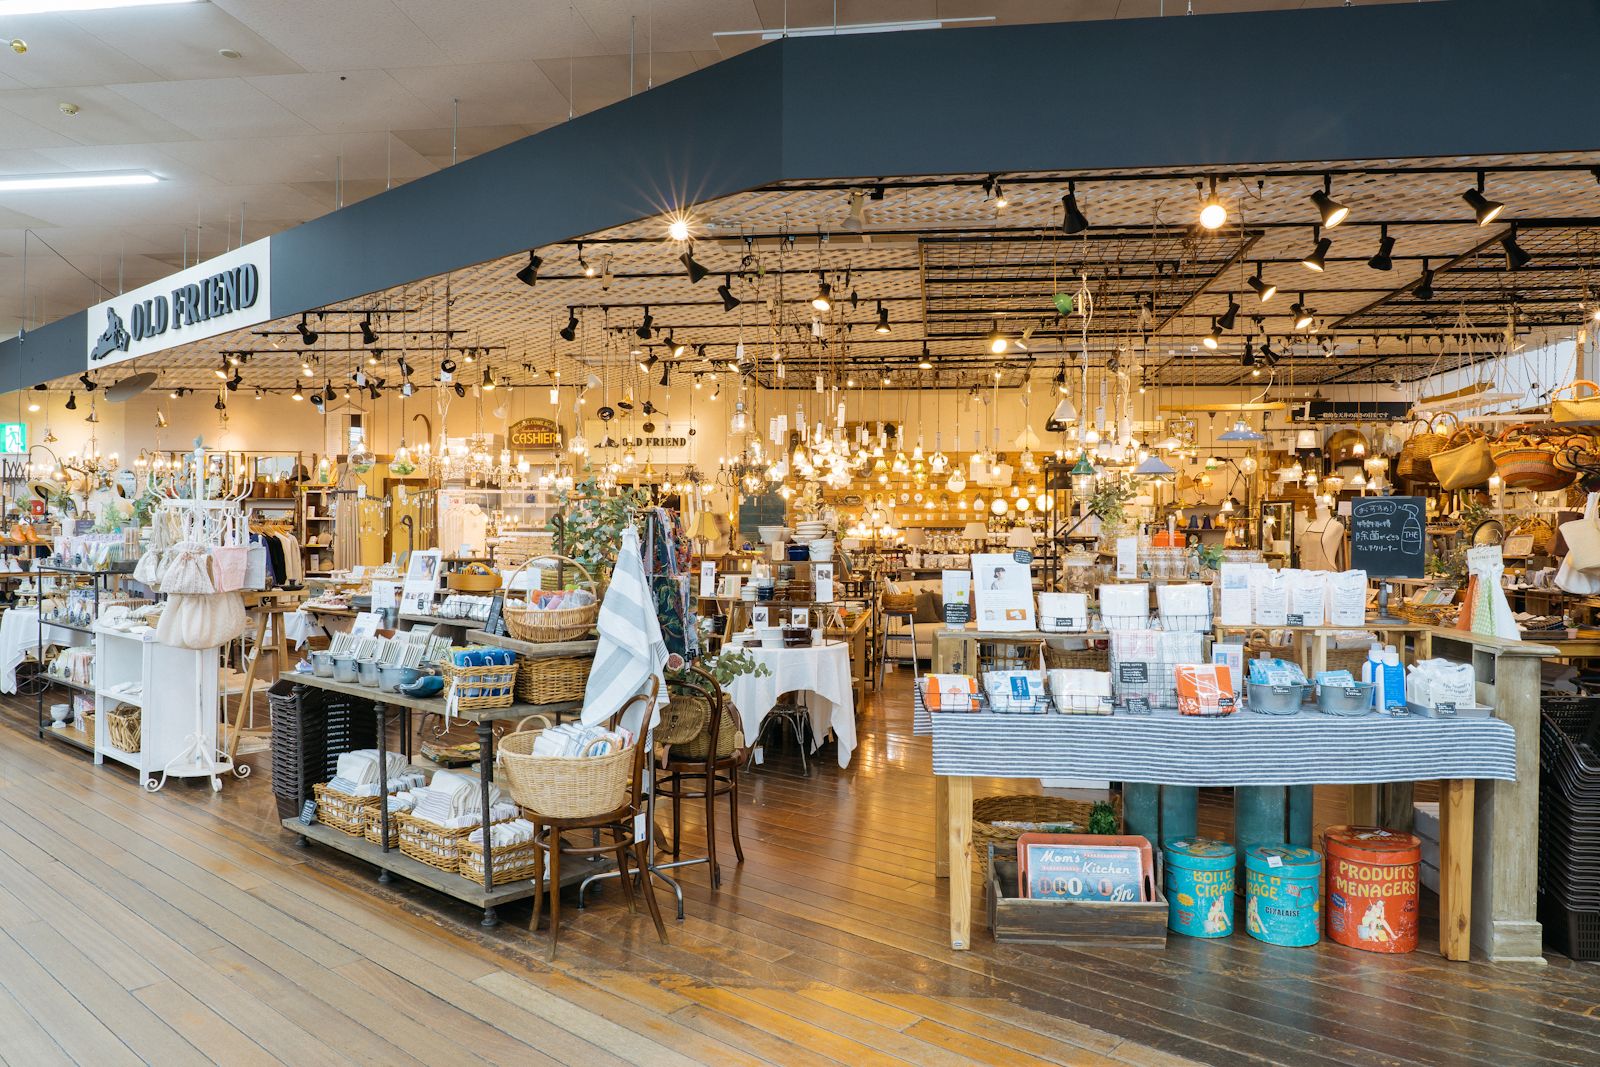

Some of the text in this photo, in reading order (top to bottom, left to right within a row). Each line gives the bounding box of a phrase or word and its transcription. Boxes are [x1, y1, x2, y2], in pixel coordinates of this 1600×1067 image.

[130, 263, 259, 342] OLD FRIEND
[511, 432, 558, 445] CASHIER
[645, 437, 687, 447] FRIEND
[1403, 531, 1419, 539] THE
[1040, 850, 1080, 863] Mom's
[1081, 861, 1131, 875] Kitchen
[1339, 861, 1415, 881] PRODUITS
[1336, 876, 1416, 898] MENAGERS
